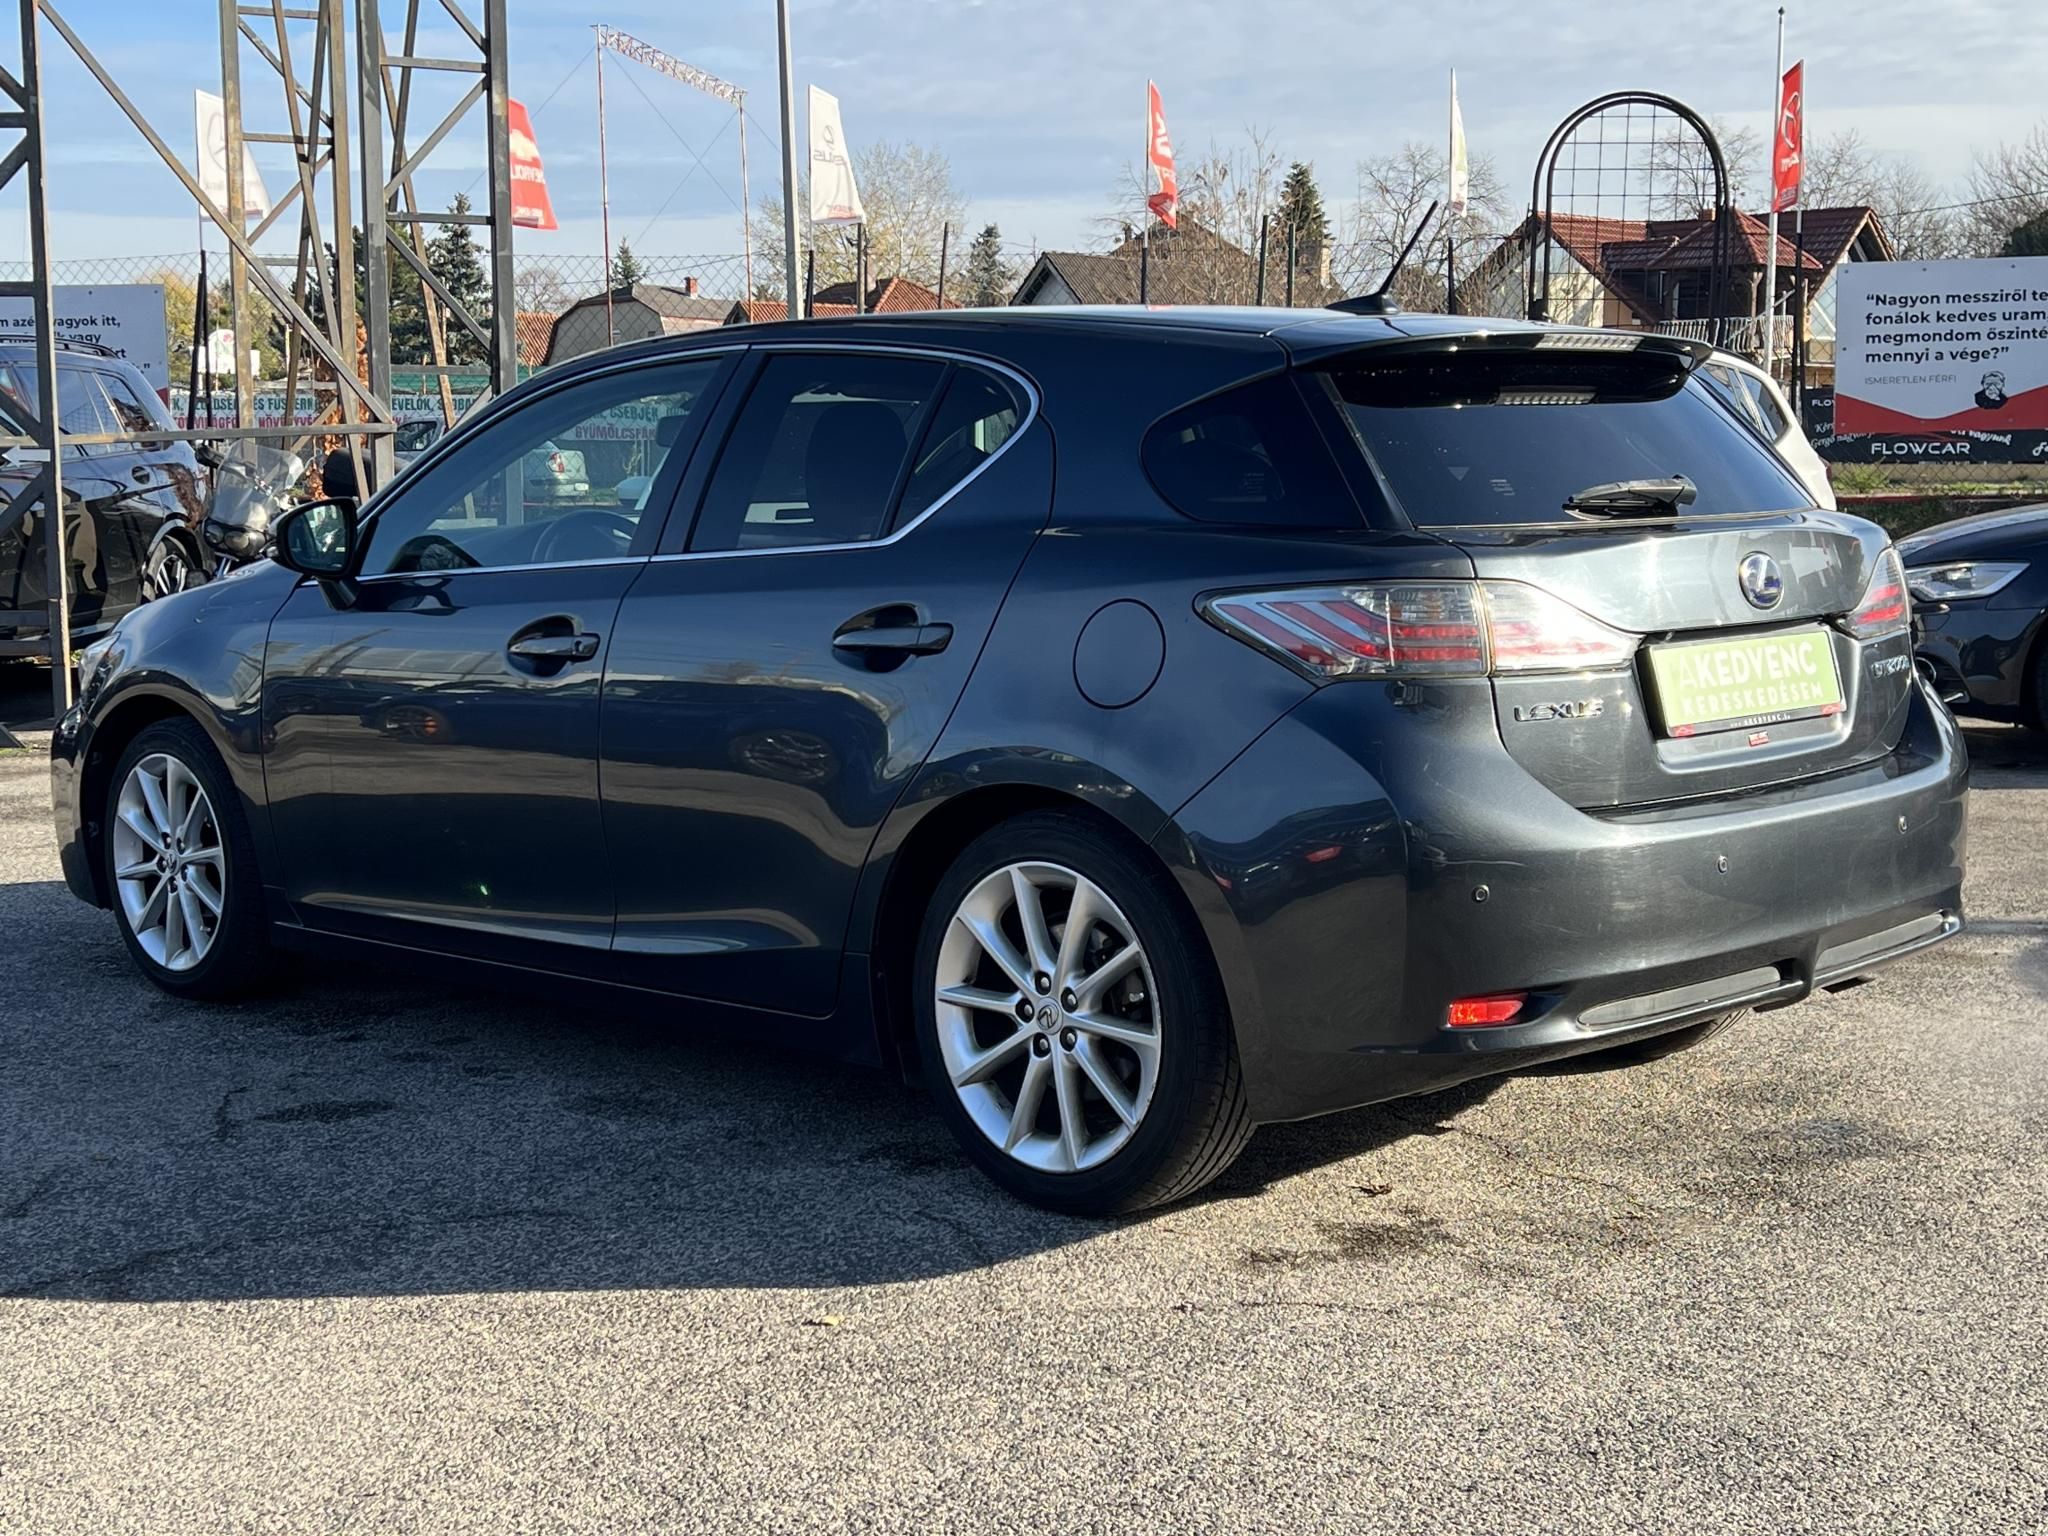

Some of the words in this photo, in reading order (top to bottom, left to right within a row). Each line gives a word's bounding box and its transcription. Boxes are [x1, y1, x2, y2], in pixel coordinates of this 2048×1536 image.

[1945, 289, 2027, 304] messziről
[102, 314, 121, 328] itt,
[1865, 311, 1931, 325] fonálok
[1936, 309, 1997, 323] kedves
[1865, 329, 1982, 346] megmondom
[1865, 348, 1930, 364] mennyi
[1934, 351, 1944, 361] a
[1864, 375, 1926, 385] ISMERETLEN
[1929, 374, 1957, 384] FÉRFI
[1870, 442, 1970, 455] FLOWCAR
[1682, 681, 1824, 717] KERESKEDÉSEM
[1513, 699, 1604, 722] LEXUS
